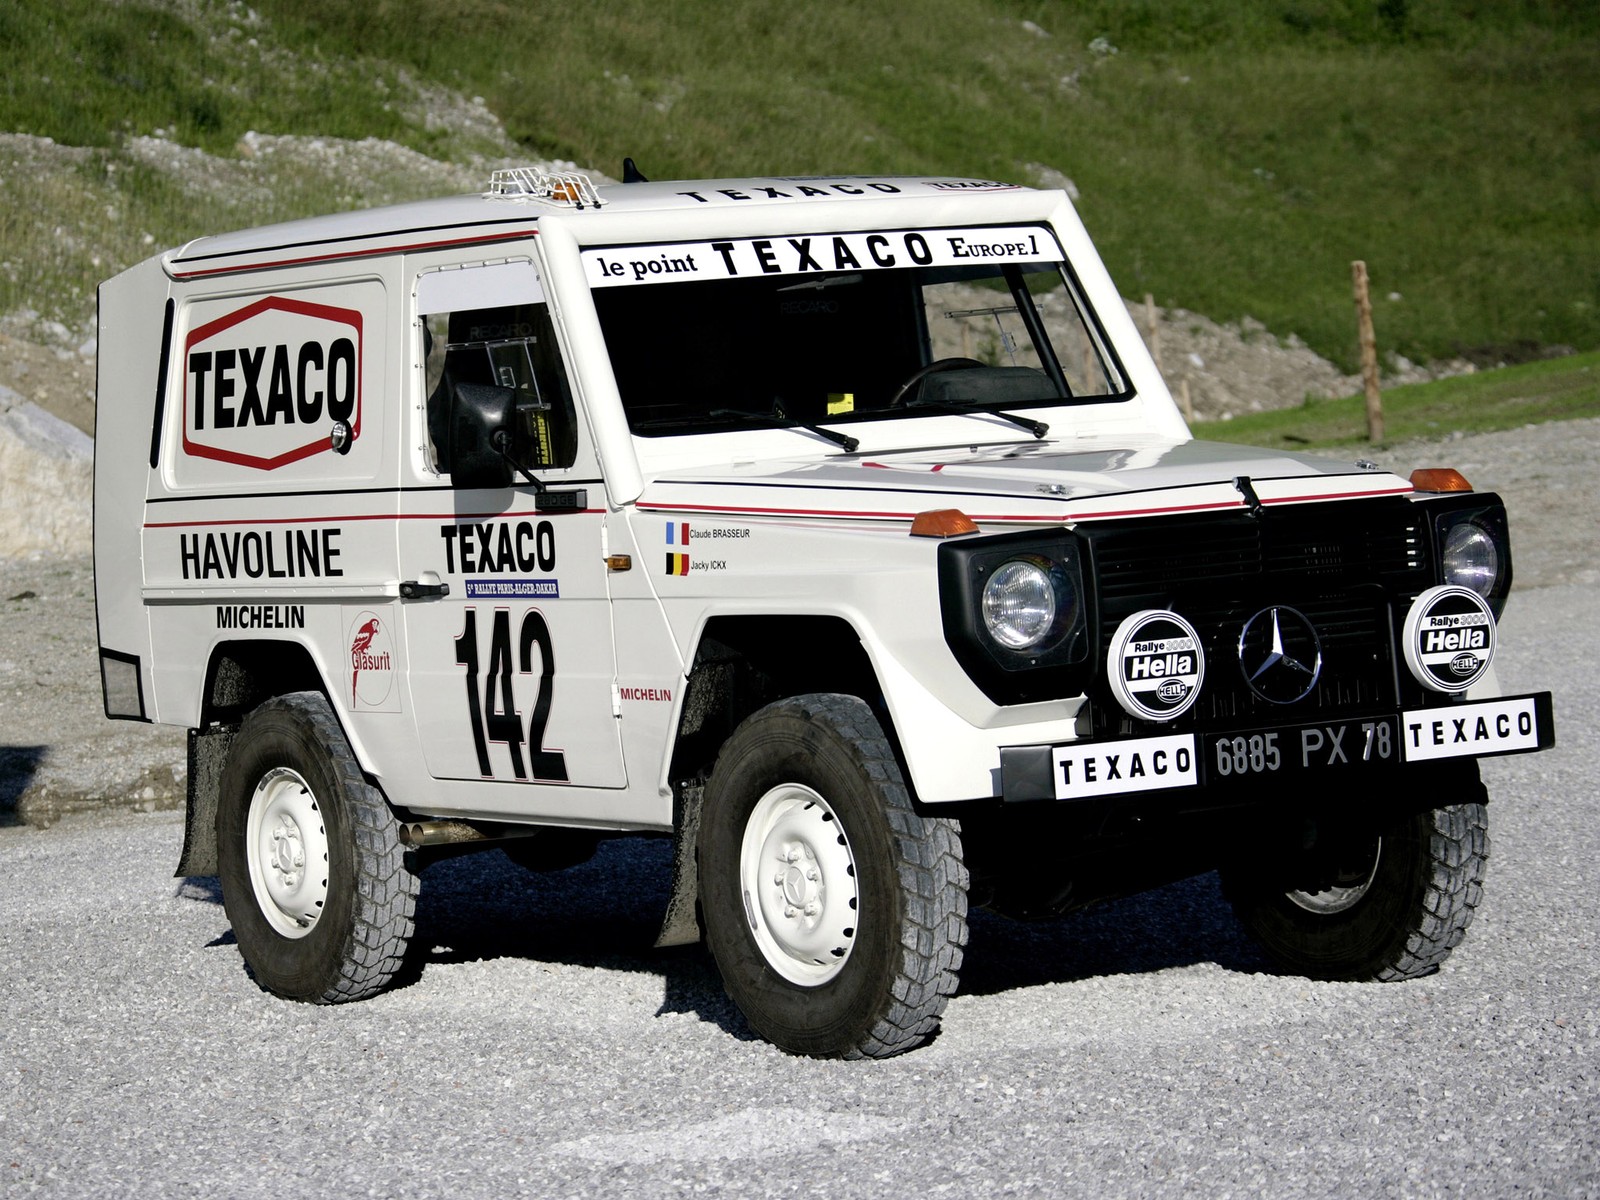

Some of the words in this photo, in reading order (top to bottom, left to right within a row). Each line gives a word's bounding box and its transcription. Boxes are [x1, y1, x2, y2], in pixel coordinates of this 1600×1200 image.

[675, 183, 902, 203] TEXACO
[930, 181, 1017, 189] TEXACO
[598, 256, 625, 278] le
[629, 252, 698, 281] point
[712, 231, 933, 276] TEXACO
[468, 322, 532, 339] RECARO
[189, 336, 356, 431] TEXACO
[690, 529, 711, 539] Claude
[713, 528, 750, 538] BRASSEUR
[180, 527, 344, 580] HAVOLINE
[441, 520, 556, 575] TEXACO
[691, 560, 710, 572] Jacky
[710, 560, 727, 570] ICKX
[474, 583, 497, 594] RALLYE
[216, 605, 305, 629] MICHELIN
[1430, 616, 1459, 627] Rallye
[1460, 613, 1487, 626] 3000
[1134, 641, 1165, 653] Rallye
[1166, 638, 1194, 651] 3000
[1426, 628, 1485, 652] Hella
[351, 650, 391, 671] Glasurit
[1131, 653, 1192, 679] Hella
[1452, 658, 1479, 669] HELLA
[454, 606, 570, 785] 142
[620, 687, 672, 702] MICHELIN
[1159, 683, 1187, 696] HELLA
[1409, 710, 1533, 748] TEXACO
[1216, 732, 1281, 777] 6885
[1302, 727, 1349, 769] PX
[1362, 722, 1392, 761] 78
[1059, 744, 1192, 786] TEXACO
